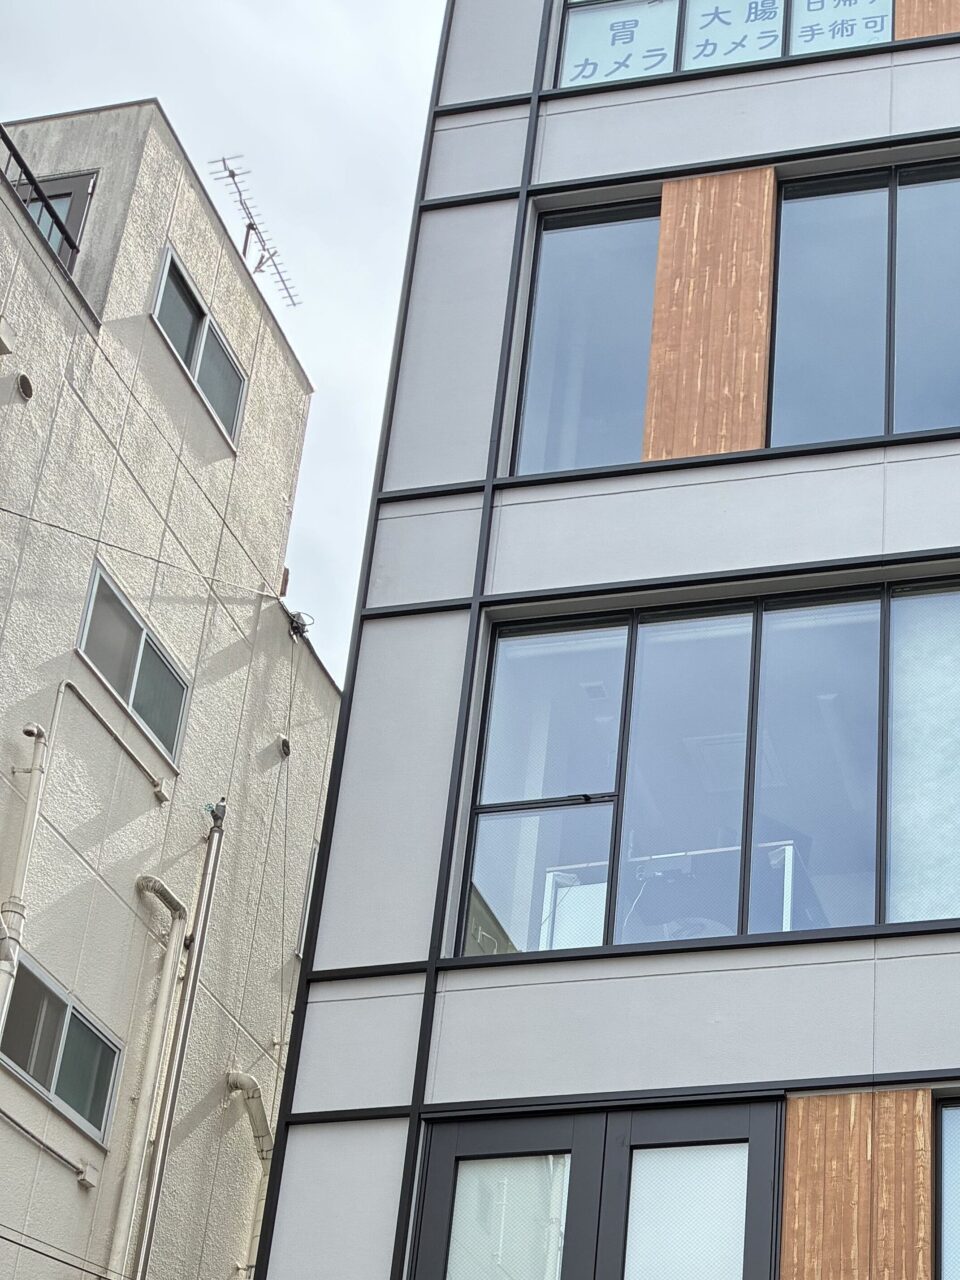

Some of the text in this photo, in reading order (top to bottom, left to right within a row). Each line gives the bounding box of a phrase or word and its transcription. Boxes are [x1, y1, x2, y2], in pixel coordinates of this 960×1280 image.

[609, 19, 639, 46] 胃
[798, 14, 889, 43] 手術可
[692, 29, 779, 60] カメラ
[569, 47, 668, 81] カメラ
